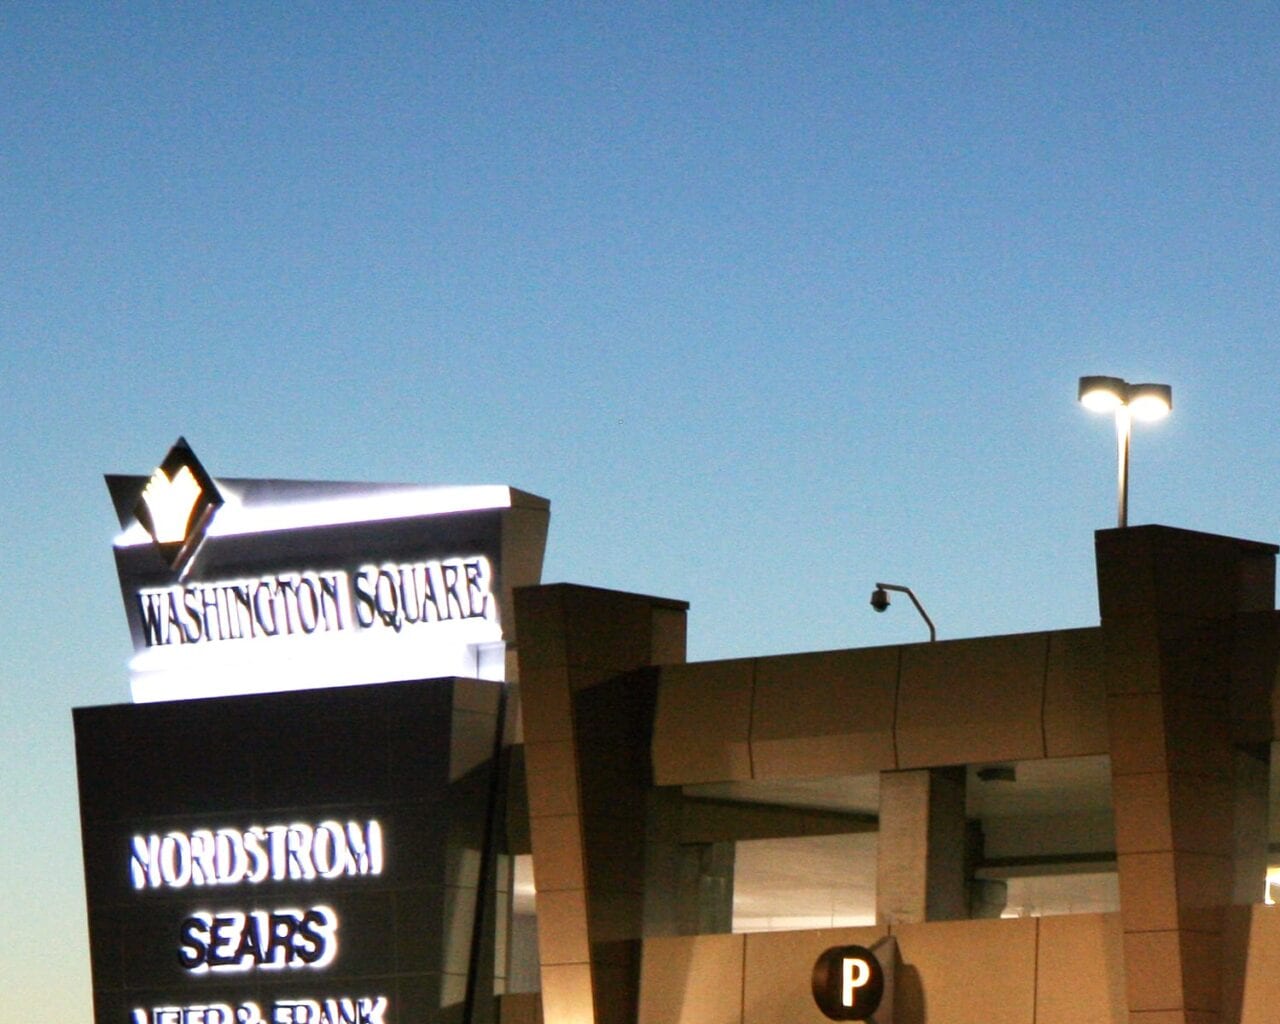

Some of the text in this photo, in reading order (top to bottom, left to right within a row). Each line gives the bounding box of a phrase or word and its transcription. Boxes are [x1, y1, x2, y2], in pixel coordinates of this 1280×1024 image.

[138, 558, 490, 647] WASHINGTON SQUARE
[131, 820, 385, 888] NORDSTROM
[179, 906, 338, 972] SEARS
[842, 958, 870, 1007] P
